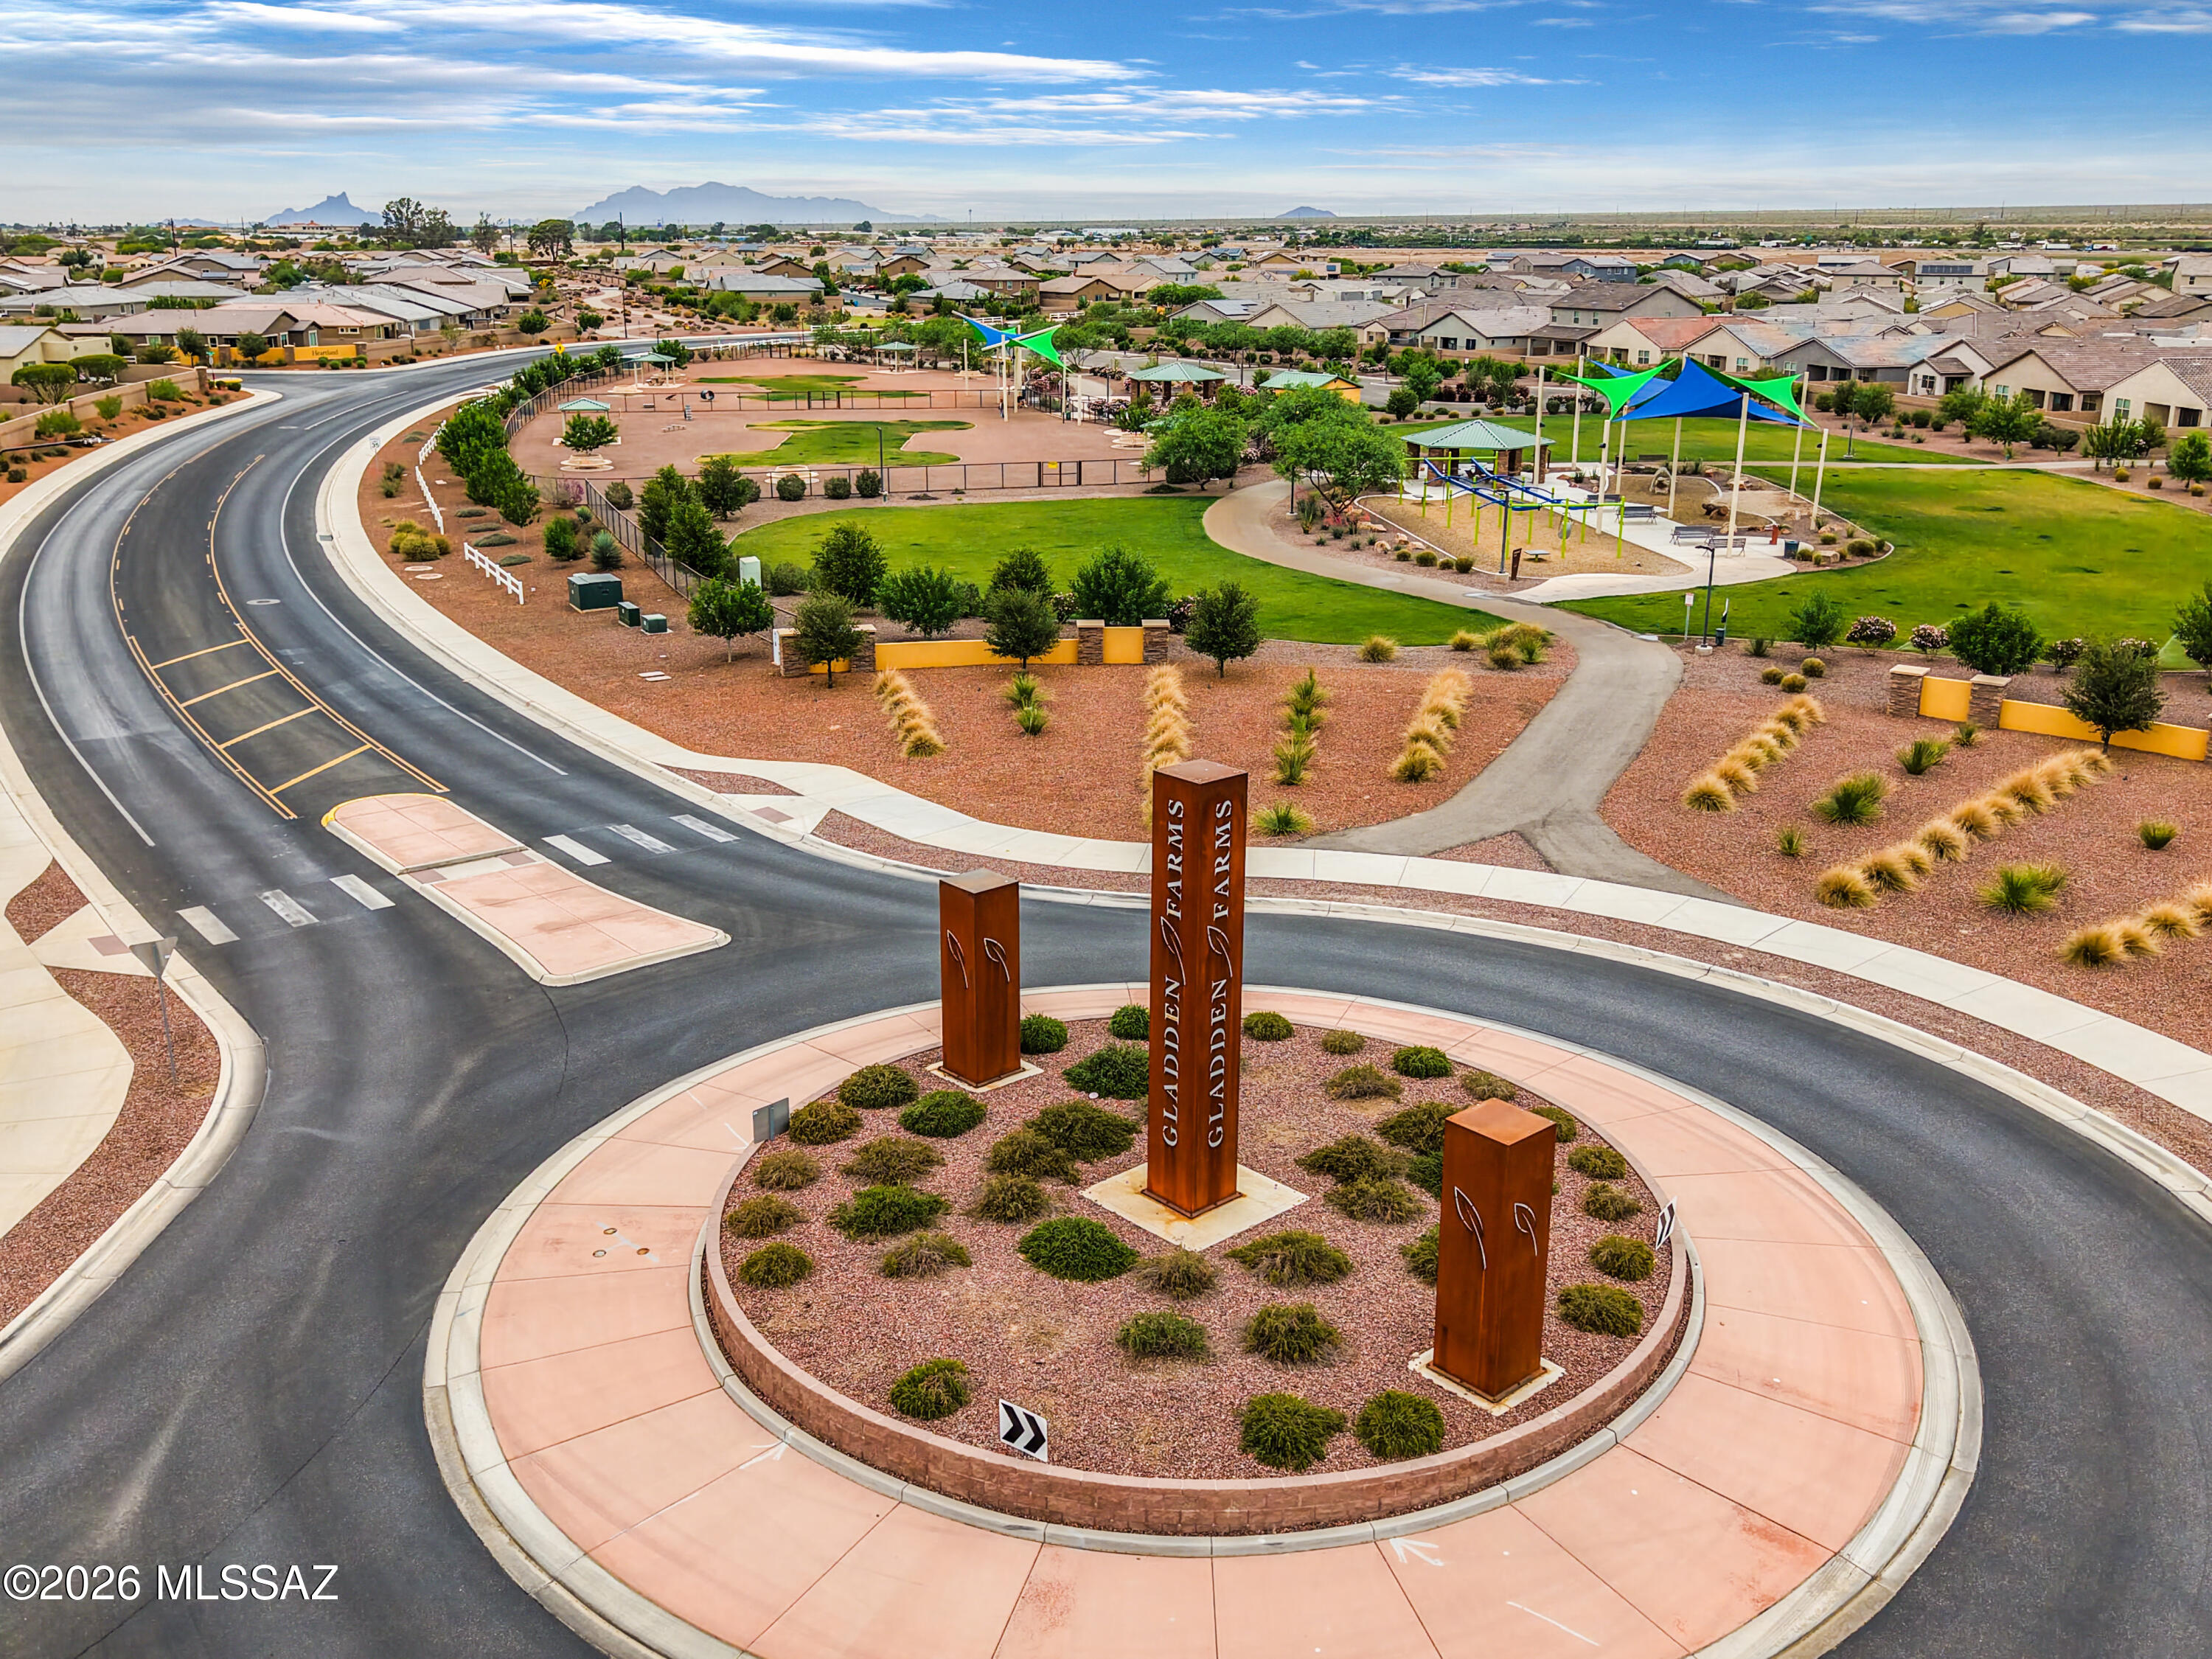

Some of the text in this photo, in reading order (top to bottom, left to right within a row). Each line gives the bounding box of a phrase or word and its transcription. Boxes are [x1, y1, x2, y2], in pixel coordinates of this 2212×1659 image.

[1162, 799, 1184, 1147] GLADDEN FARMS
[1208, 799, 1232, 1148] GLADDEN FARMS
